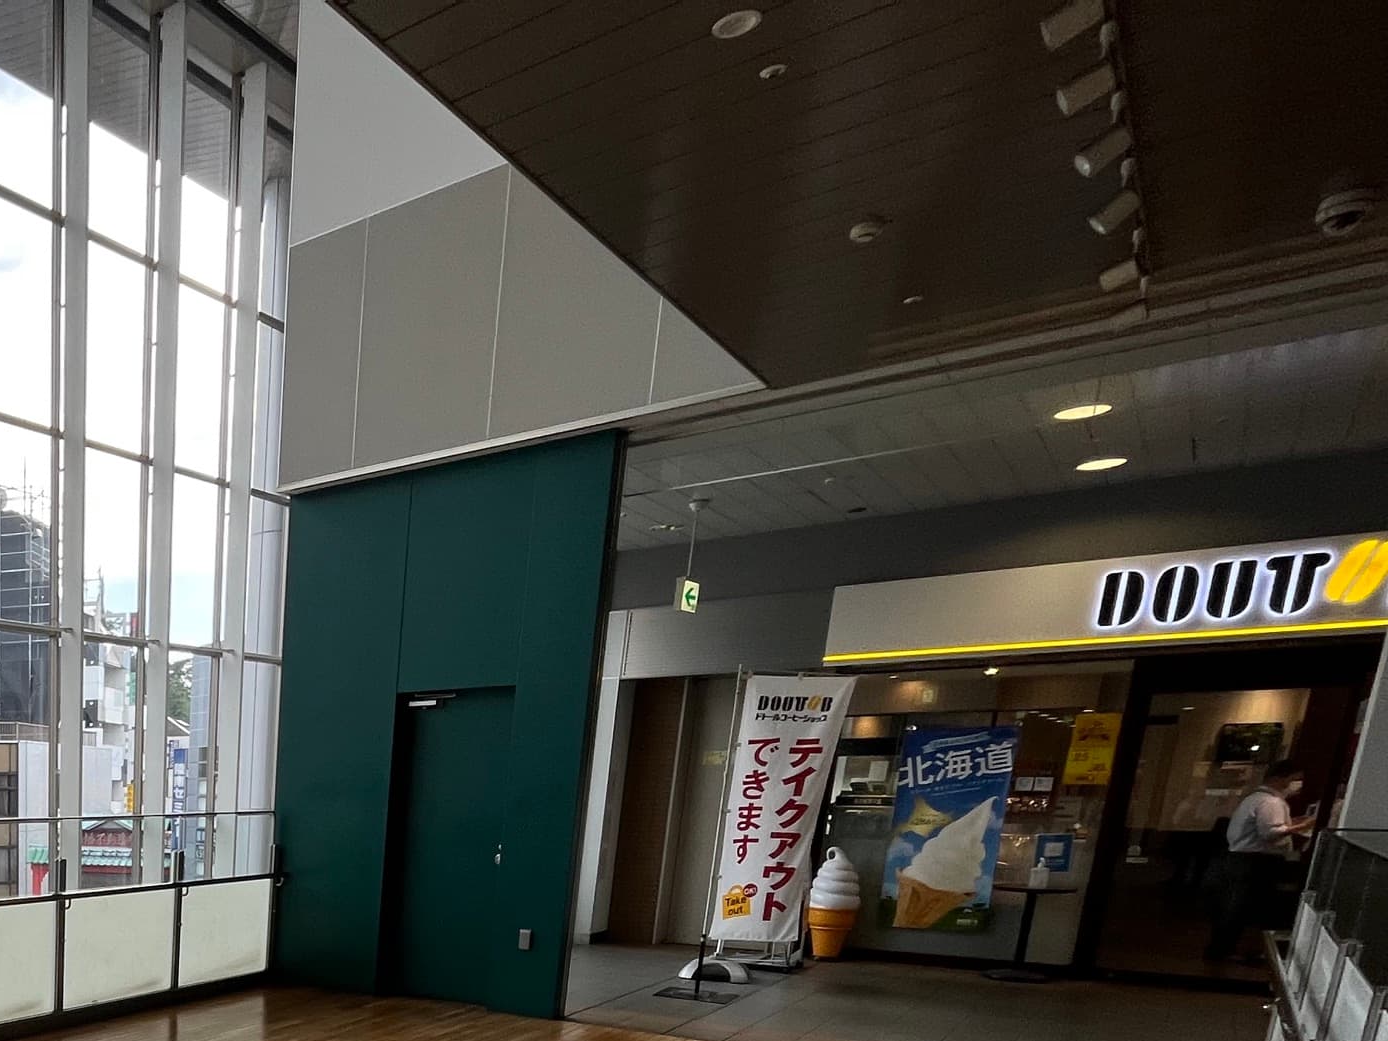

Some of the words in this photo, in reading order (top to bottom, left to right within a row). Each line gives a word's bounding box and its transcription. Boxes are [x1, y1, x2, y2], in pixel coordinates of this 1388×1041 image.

[897, 740, 1013, 788] 北海道
[732, 737, 781, 864] できます
[762, 738, 823, 921] テイクアウト
[725, 896, 747, 907] Take
[727, 906, 743, 916] out
